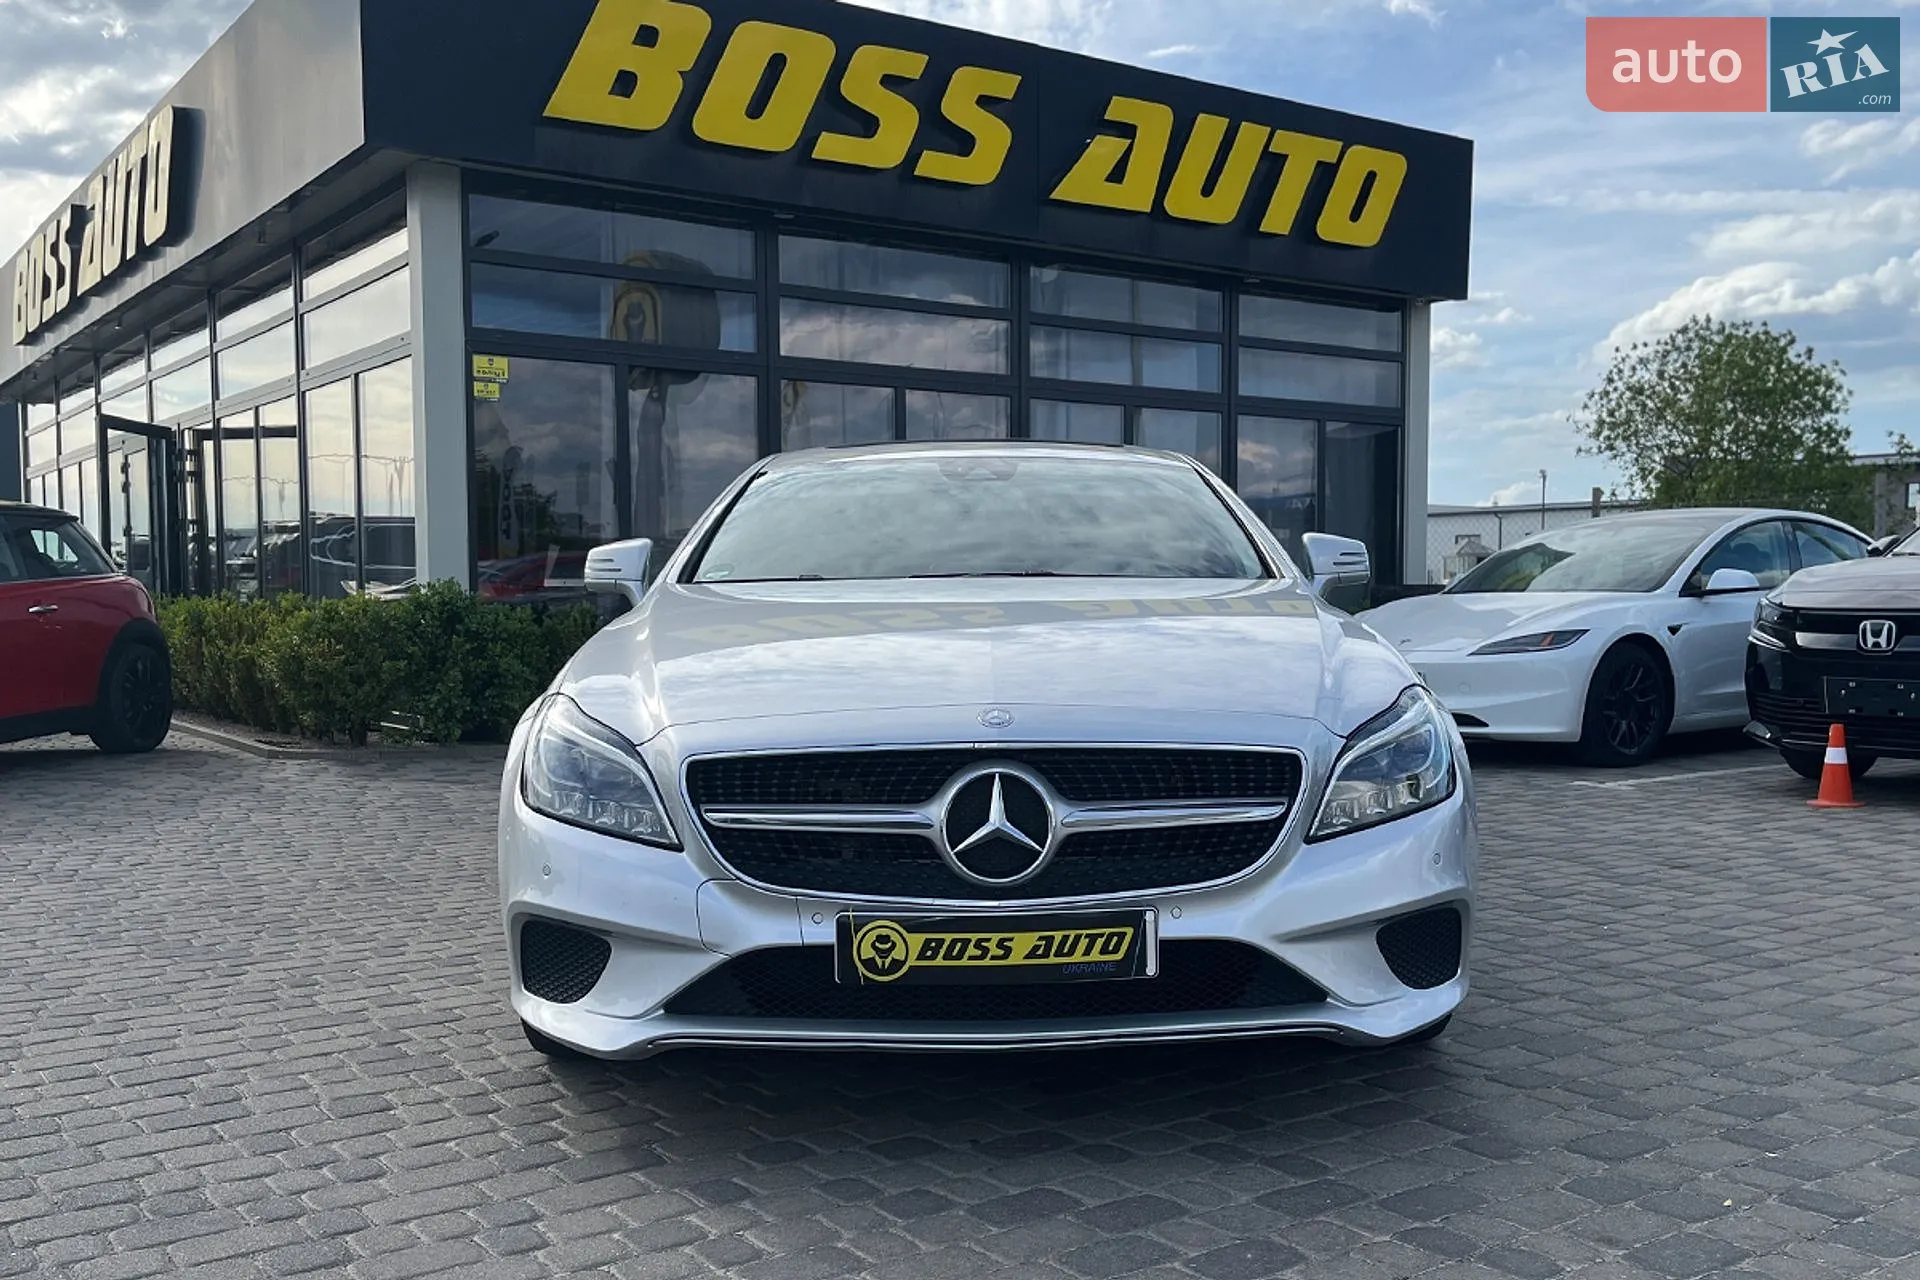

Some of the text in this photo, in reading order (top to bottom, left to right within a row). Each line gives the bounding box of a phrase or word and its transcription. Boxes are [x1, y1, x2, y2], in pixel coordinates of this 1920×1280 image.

[544, 0, 1407, 248] BOSS AUTO
[13, 104, 174, 345] BOSS AUTO
[915, 931, 1128, 961] BOSS AUTO
[1062, 962, 1117, 975] UKRAINE
